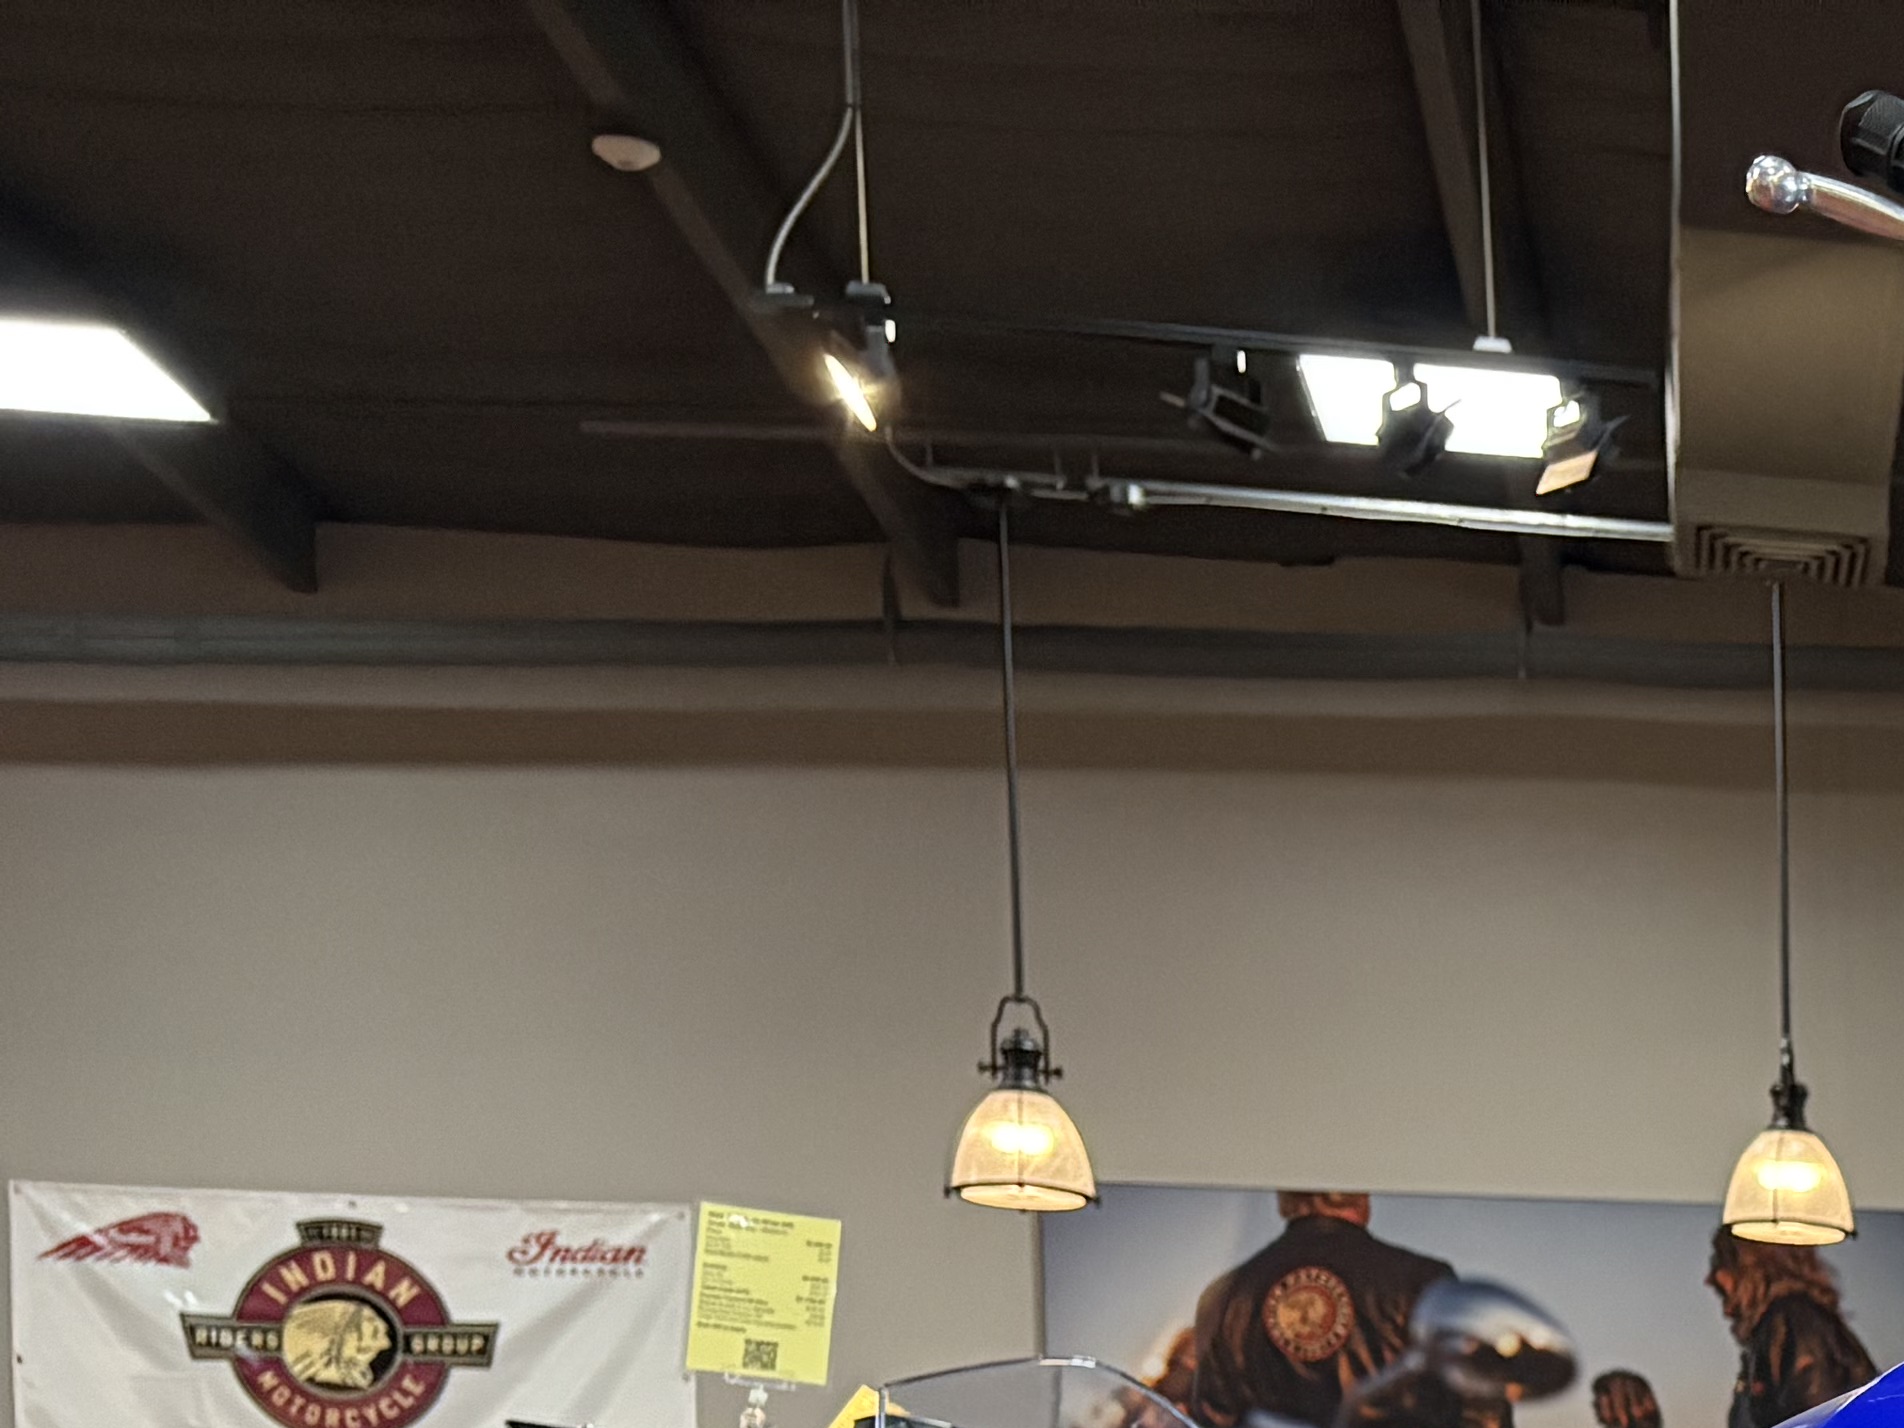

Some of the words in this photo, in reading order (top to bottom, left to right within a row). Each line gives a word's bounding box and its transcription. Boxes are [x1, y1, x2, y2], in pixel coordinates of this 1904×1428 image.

[506, 1230, 647, 1266] Indian
[261, 1250, 423, 1306] INDIAN
[194, 1326, 280, 1349] RIDERS
[409, 1333, 486, 1354] GROUP
